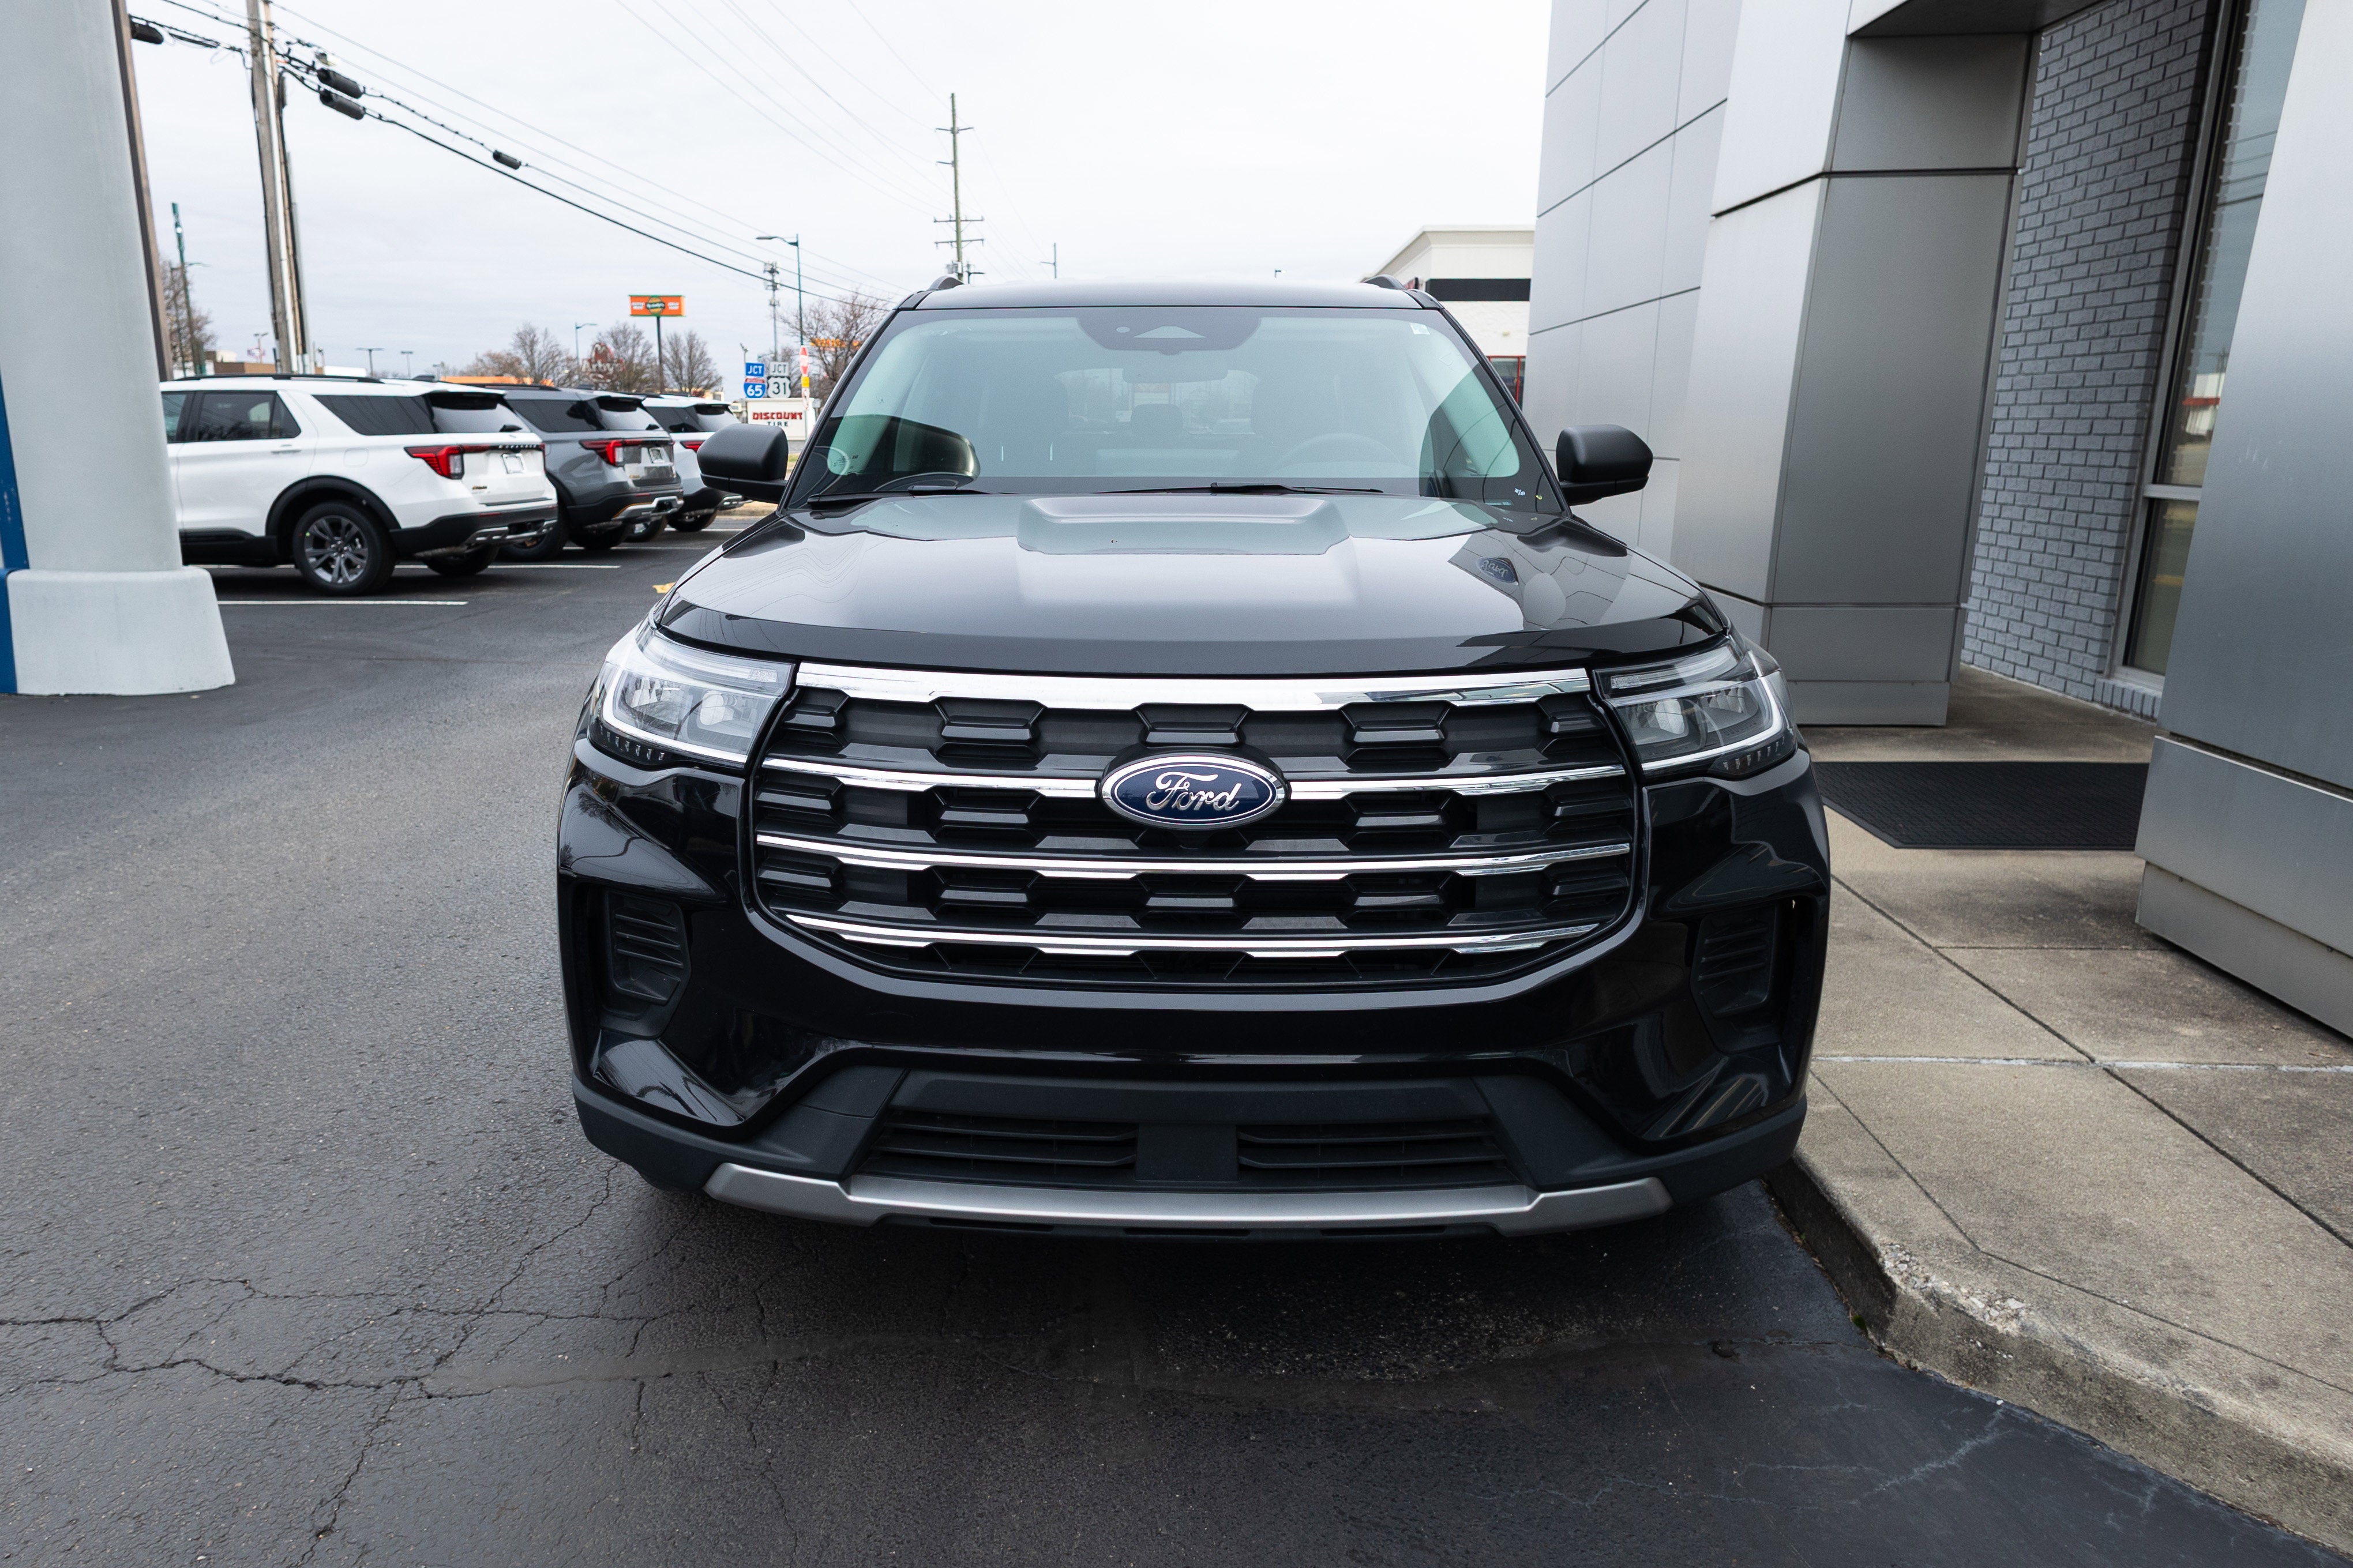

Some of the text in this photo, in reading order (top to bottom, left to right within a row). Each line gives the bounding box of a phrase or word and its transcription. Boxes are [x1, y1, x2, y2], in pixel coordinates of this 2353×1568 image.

[748, 365, 763, 374] JCT
[772, 364, 787, 373] JCT
[747, 385, 763, 397] 65
[772, 381, 786, 395] 31
[753, 412, 802, 420] DISCOUNT
[1146, 771, 1242, 811] Ford
